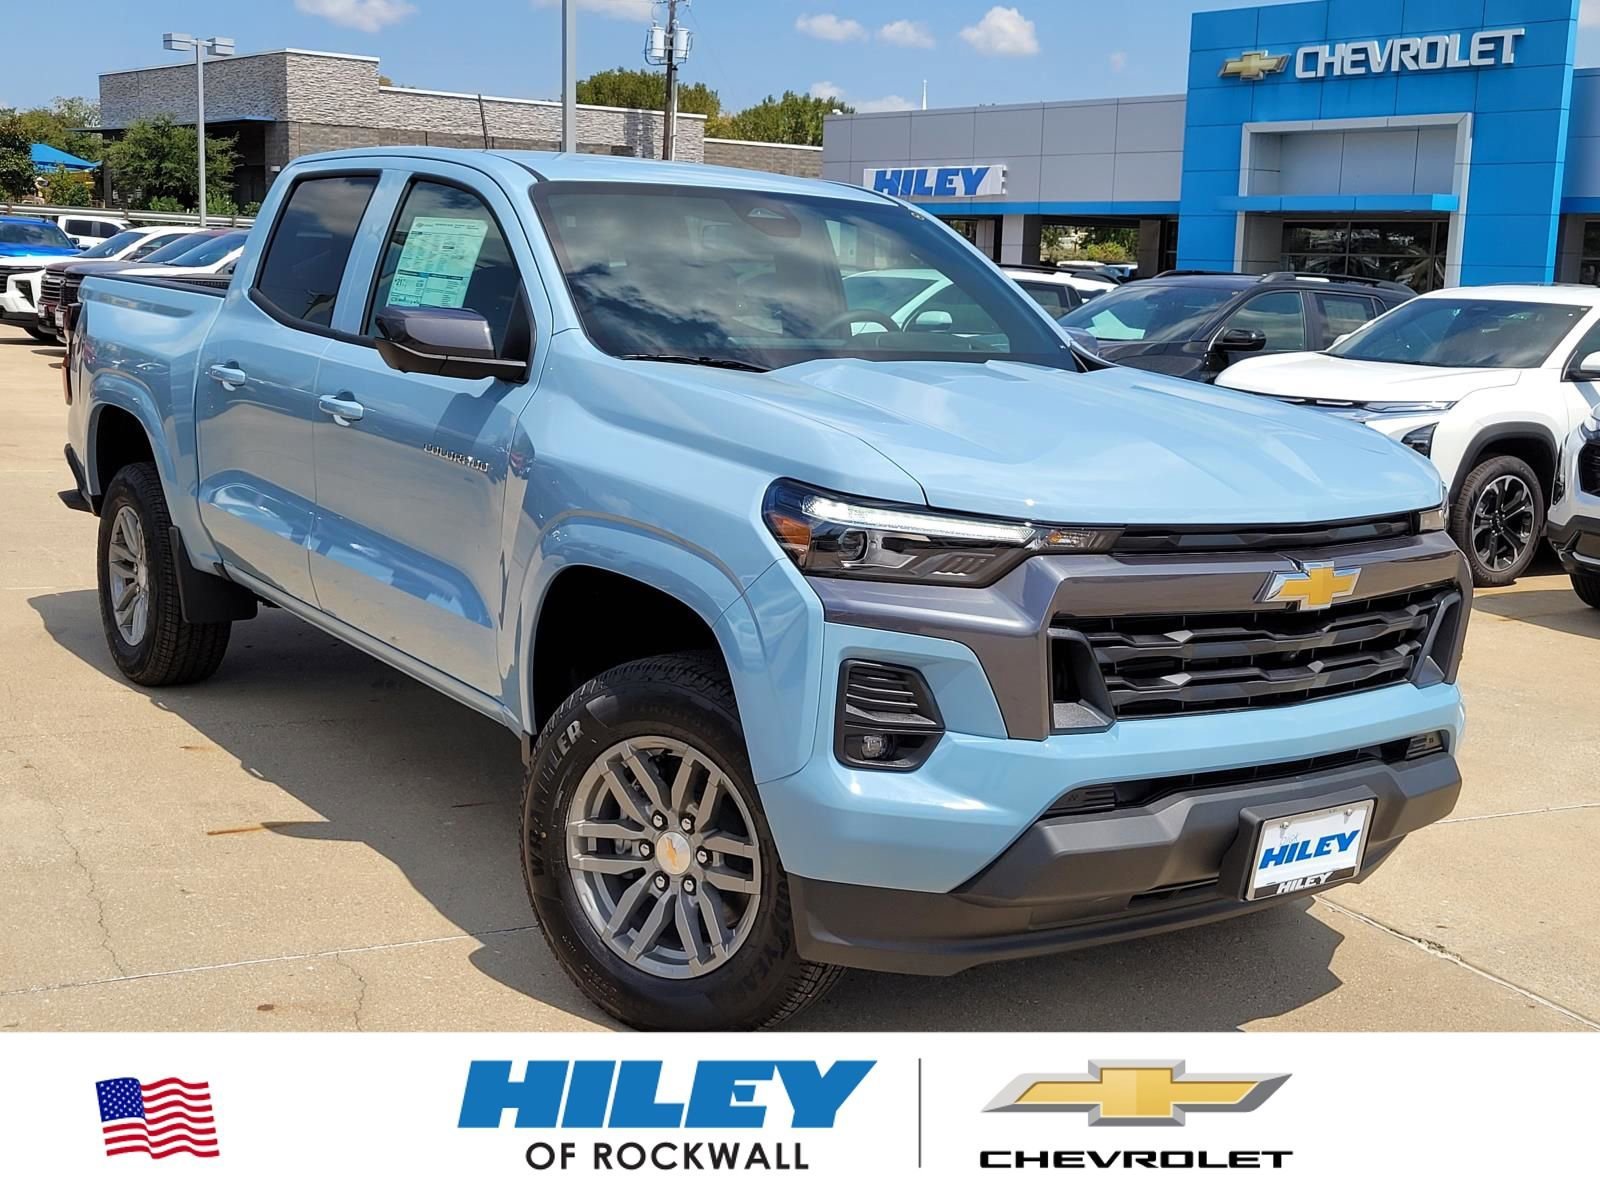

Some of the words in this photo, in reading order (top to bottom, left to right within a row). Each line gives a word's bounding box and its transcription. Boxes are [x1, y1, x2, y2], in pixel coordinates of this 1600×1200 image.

[1295, 28, 1525, 79] CHEVROLET
[874, 166, 991, 197] HILEY
[1258, 829, 1360, 870] HILEY
[1276, 872, 1333, 894] HILEY
